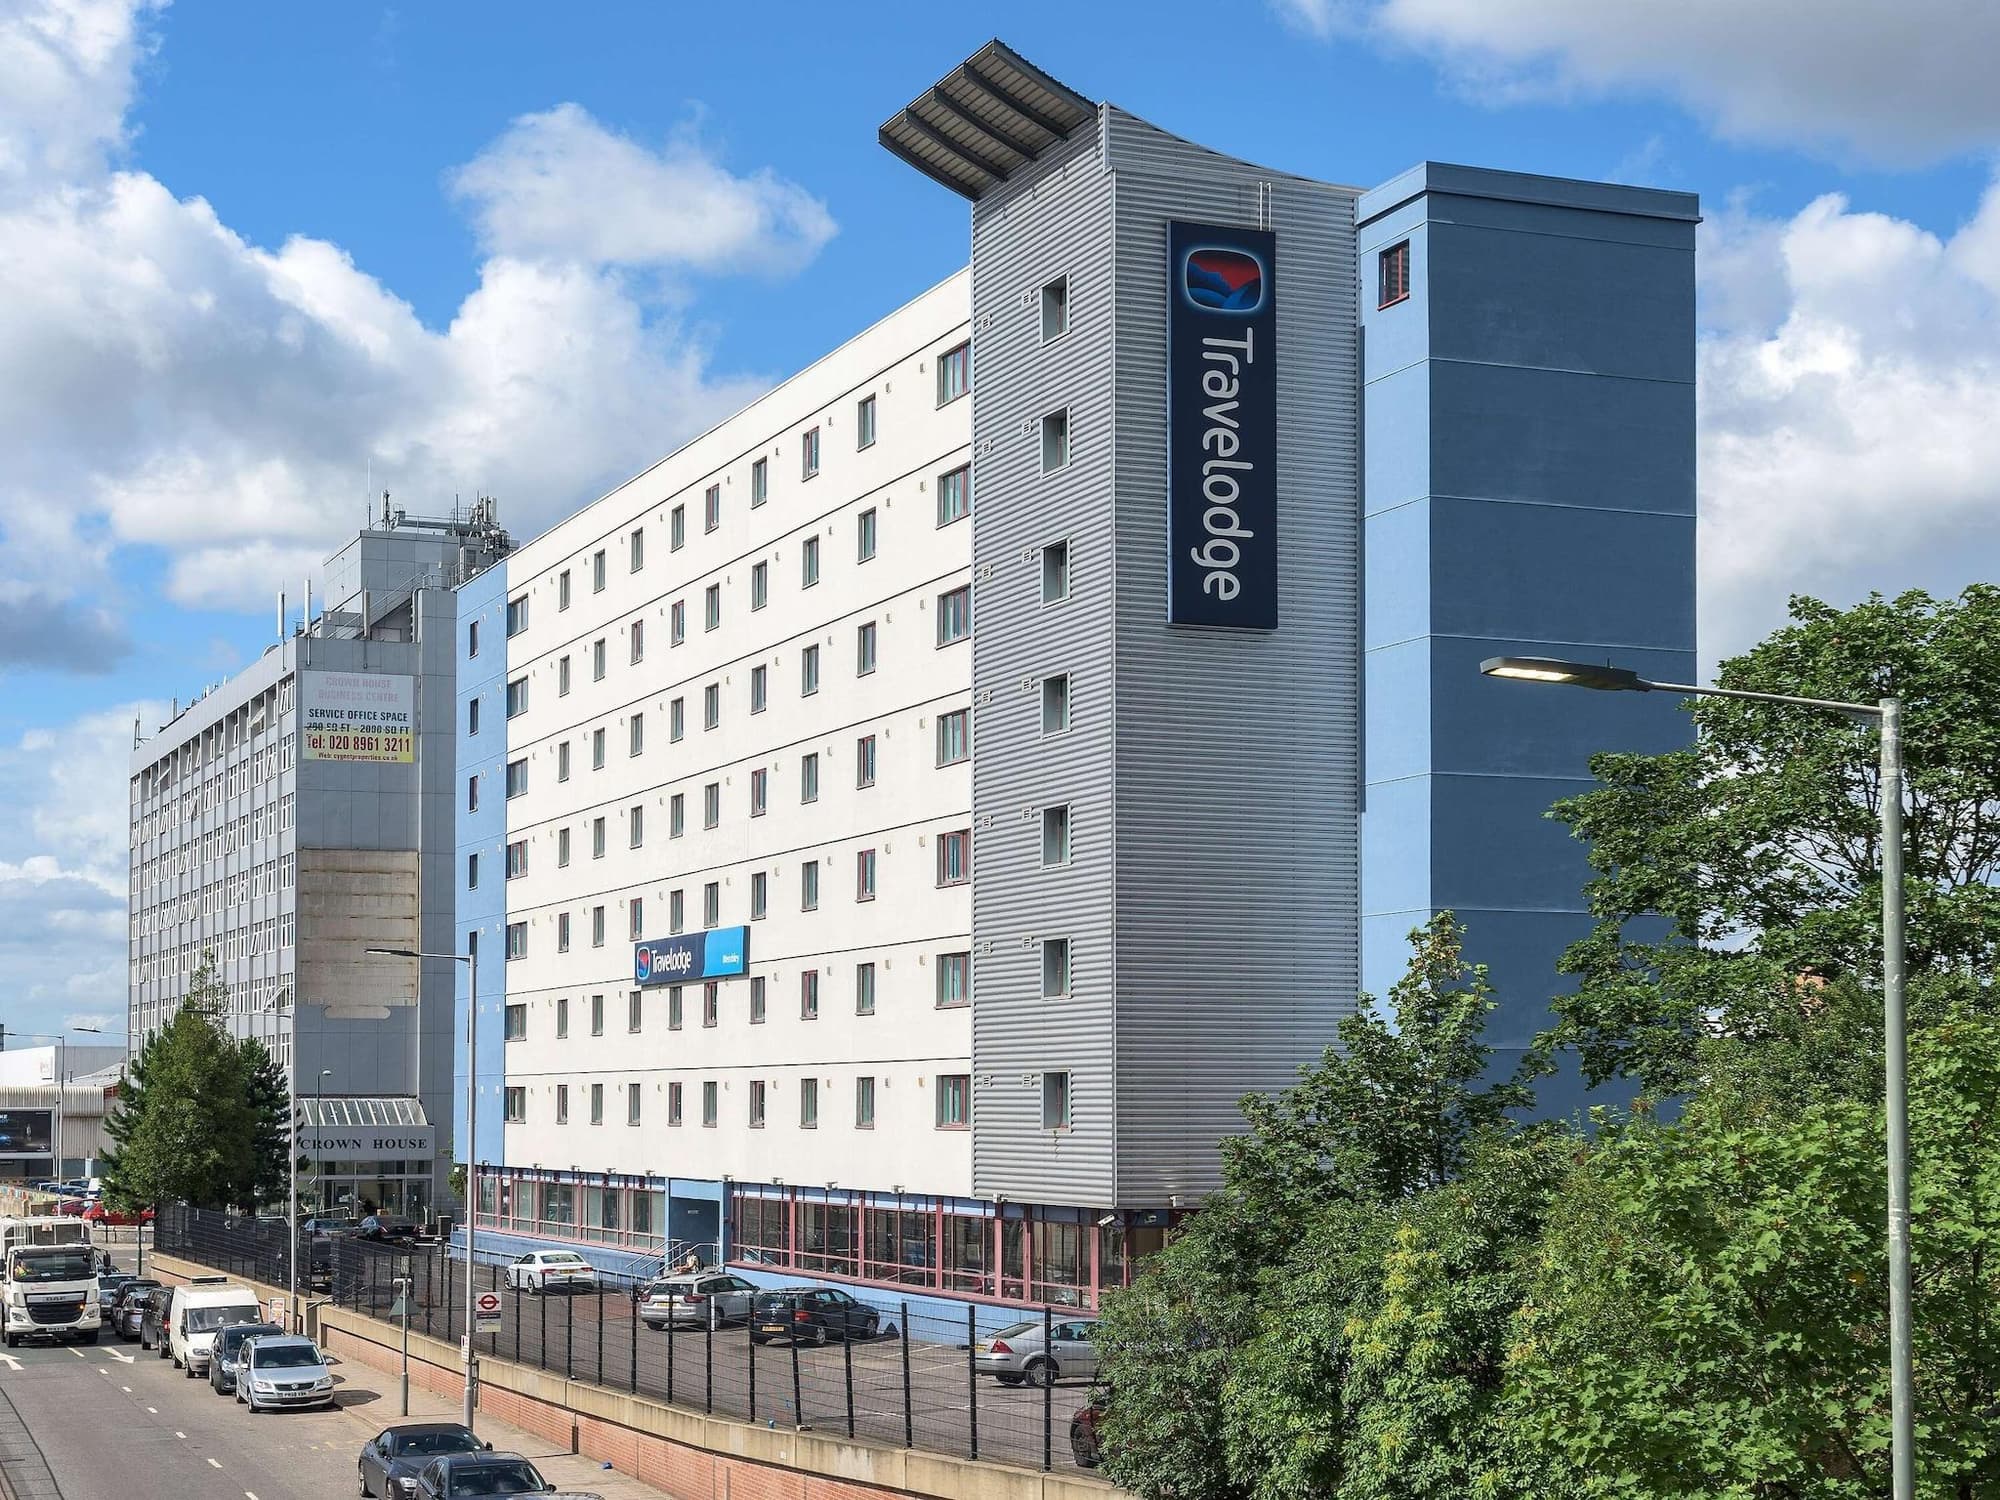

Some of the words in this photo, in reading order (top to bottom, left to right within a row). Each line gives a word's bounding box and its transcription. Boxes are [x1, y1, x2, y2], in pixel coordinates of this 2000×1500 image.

[1190, 326, 1254, 601] Travelodge
[308, 708, 345, 719] SERVICE
[347, 710, 378, 721] OFFICE
[380, 711, 408, 722] SPACE
[340, 723, 351, 732] FT
[359, 724, 382, 734] 2000
[384, 725, 397, 735] SQ
[400, 726, 410, 735] FT
[306, 734, 326, 749] Tel:
[329, 735, 349, 750] 020
[353, 736, 379, 751] 8961
[384, 737, 410, 752] 3211
[651, 946, 692, 975] Travelodge
[300, 1138, 362, 1150] CROWN
[373, 1138, 428, 1150] HOUSE
